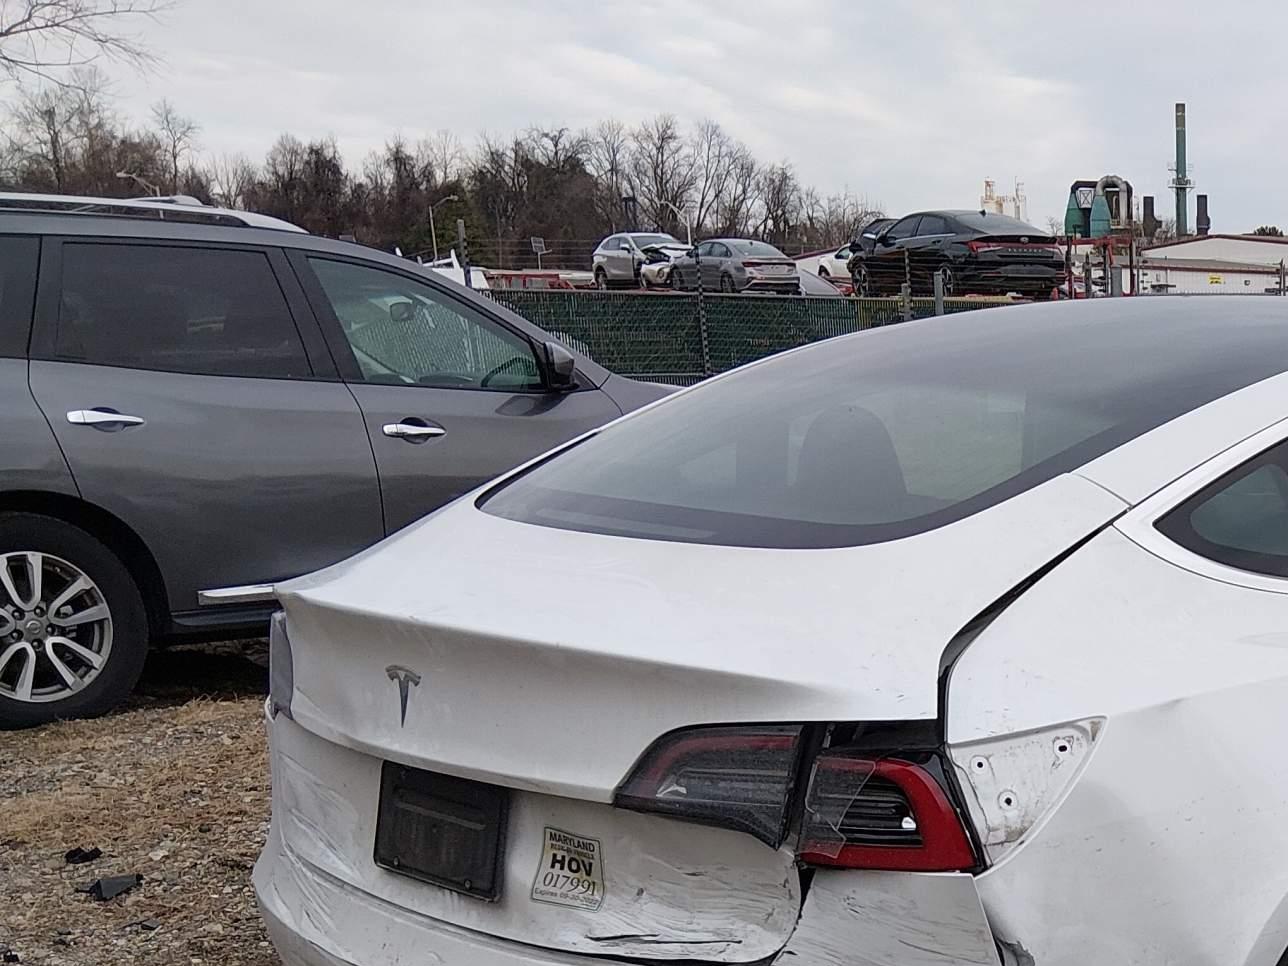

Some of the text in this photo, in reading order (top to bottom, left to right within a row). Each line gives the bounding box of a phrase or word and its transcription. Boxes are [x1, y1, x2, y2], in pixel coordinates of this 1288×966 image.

[549, 832, 595, 852] MARYLAND
[550, 853, 593, 877] HOV
[543, 871, 596, 896] 017991
